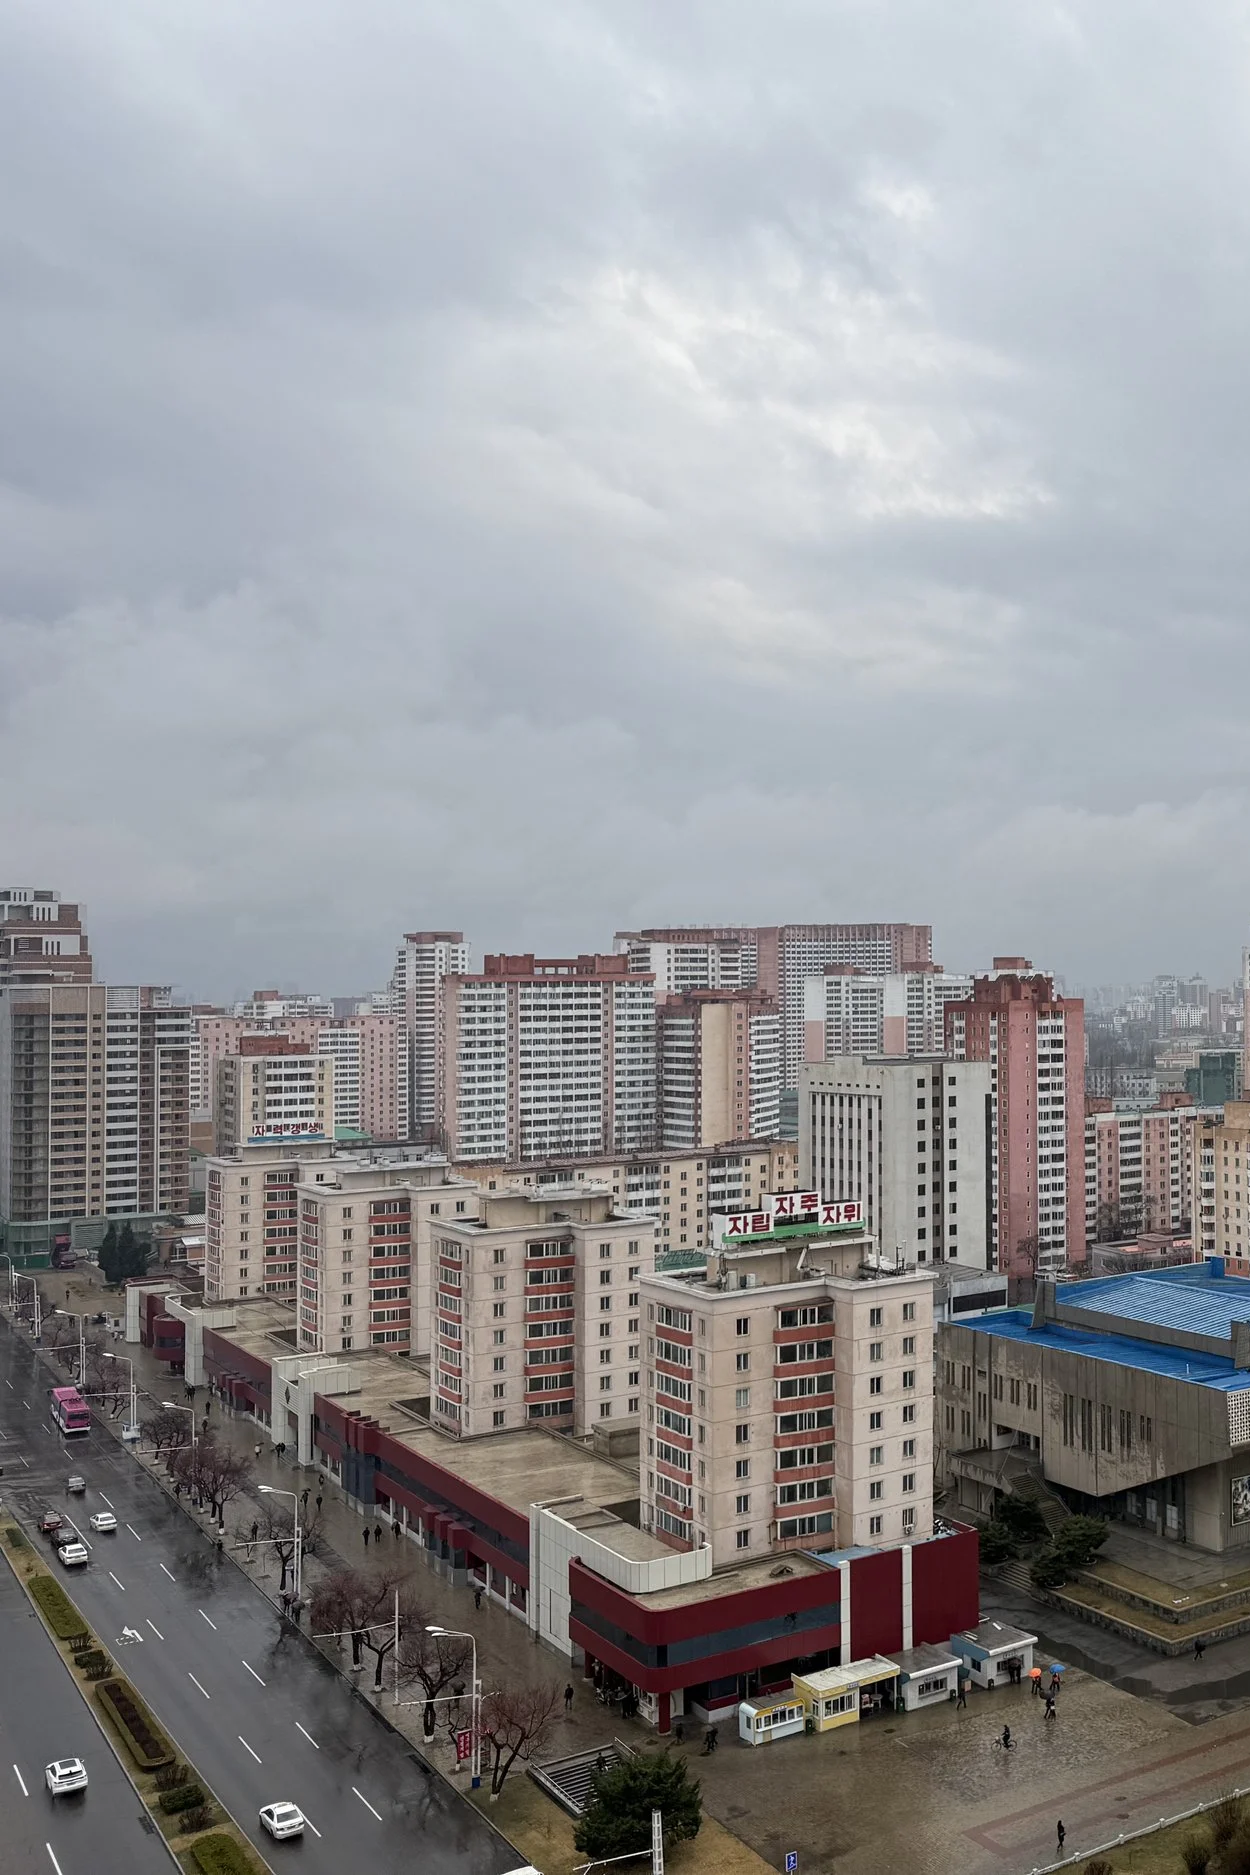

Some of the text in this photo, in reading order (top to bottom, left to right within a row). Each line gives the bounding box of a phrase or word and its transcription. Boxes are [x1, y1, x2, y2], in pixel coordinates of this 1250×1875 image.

[255, 1122, 319, 1136] 자력갱생
[728, 1193, 861, 1235] 자립 자주 자위
